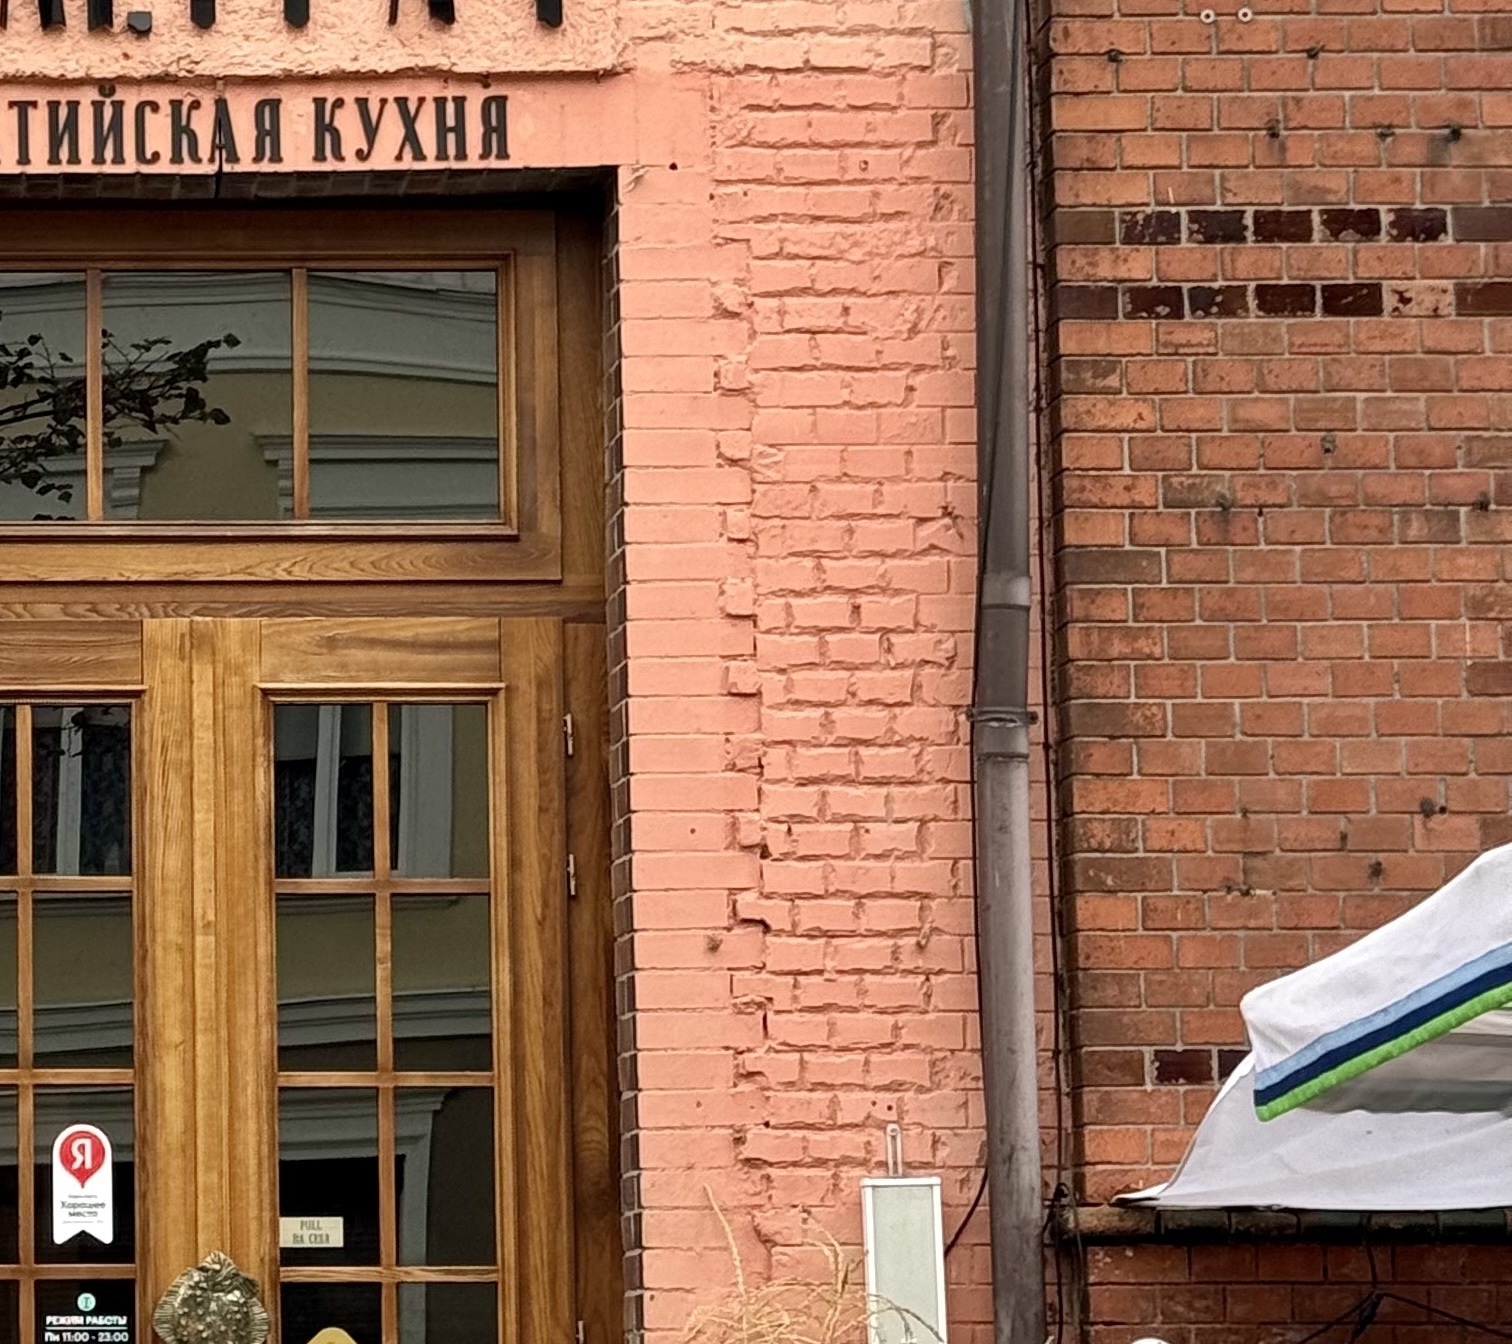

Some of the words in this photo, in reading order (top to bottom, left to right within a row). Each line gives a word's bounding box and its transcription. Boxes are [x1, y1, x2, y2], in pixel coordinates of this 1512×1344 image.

[312, 94, 512, 164] КУХНЯ
[62, 1331, 90, 1343] 11:00
[97, 1331, 129, 1343] 23:00
